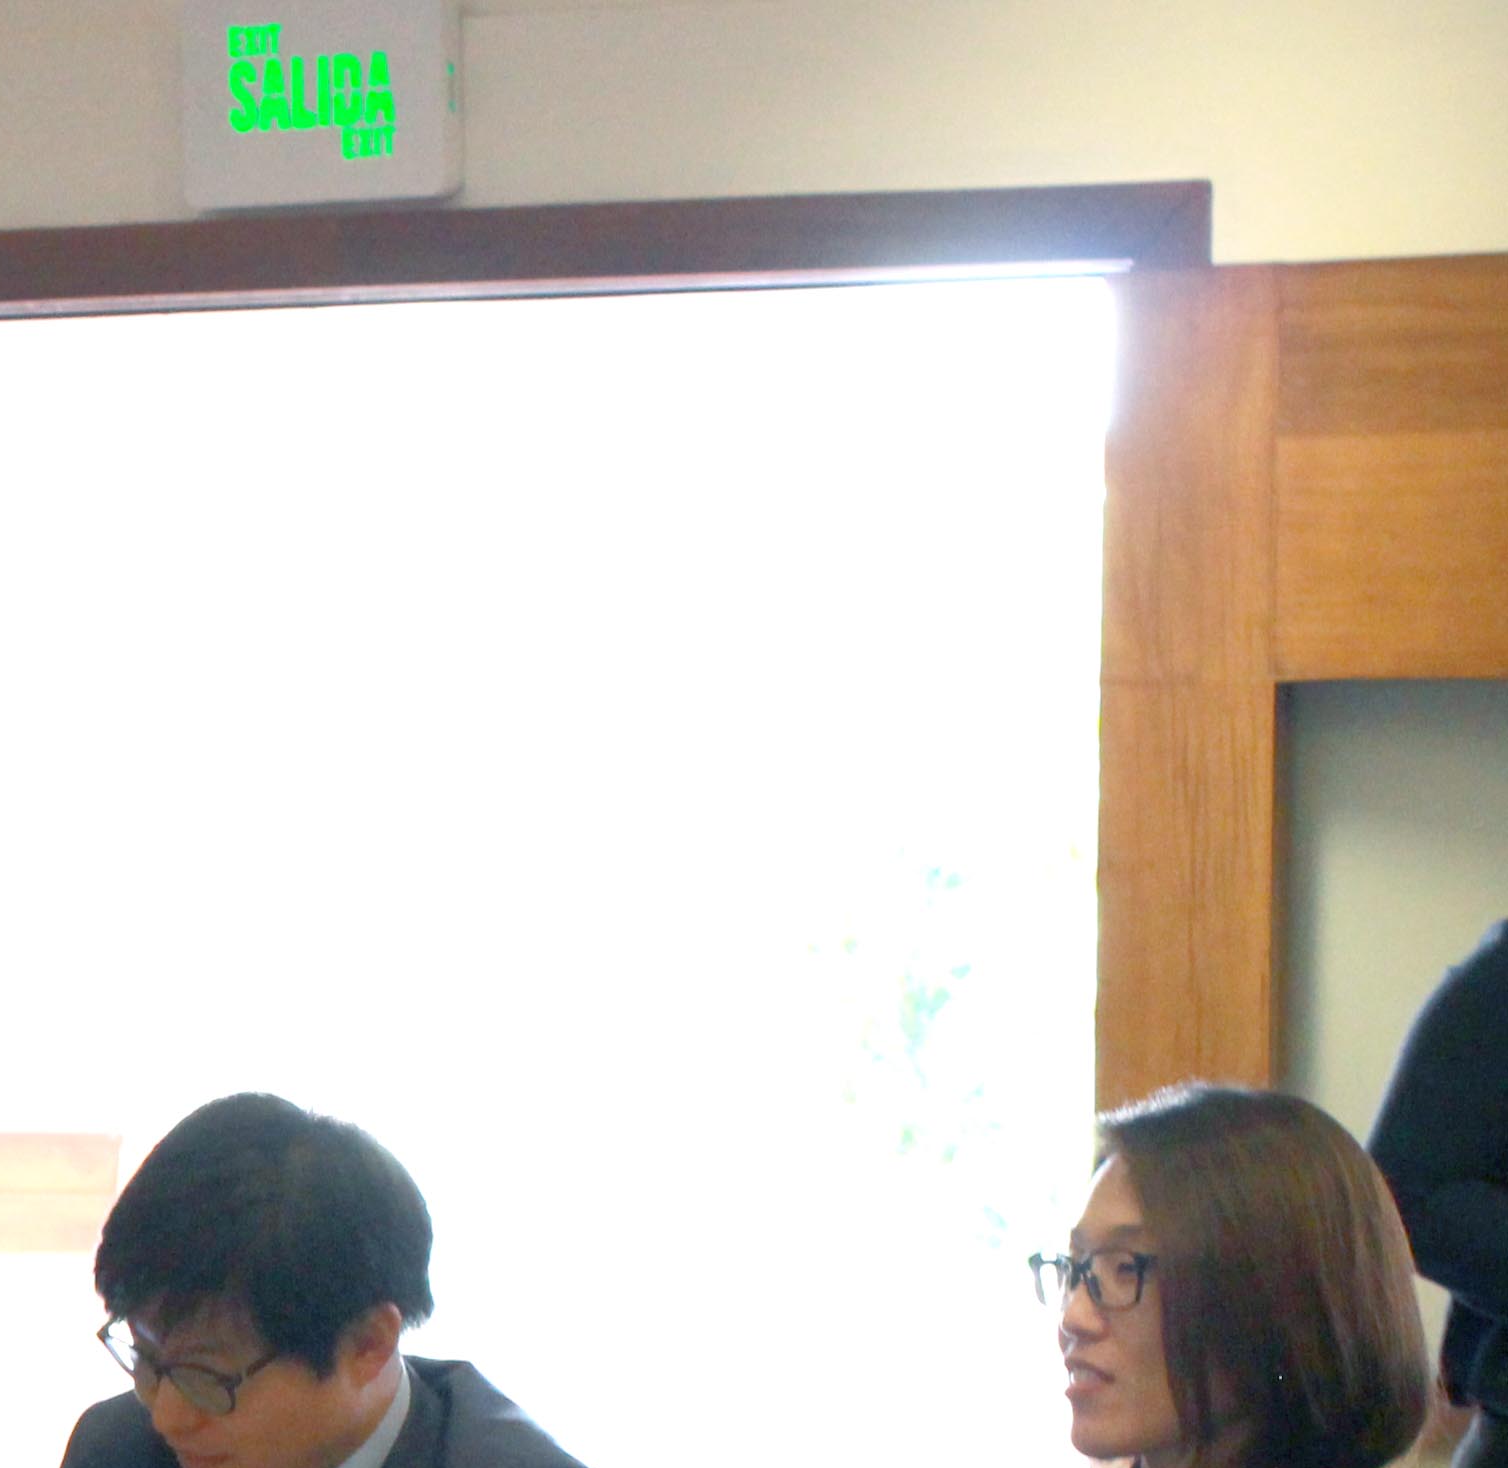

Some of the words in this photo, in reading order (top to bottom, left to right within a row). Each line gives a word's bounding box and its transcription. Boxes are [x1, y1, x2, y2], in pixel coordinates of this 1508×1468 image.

[227, 22, 282, 58] EXIT
[228, 50, 395, 132] SALIDA
[341, 125, 395, 161] EXIT
